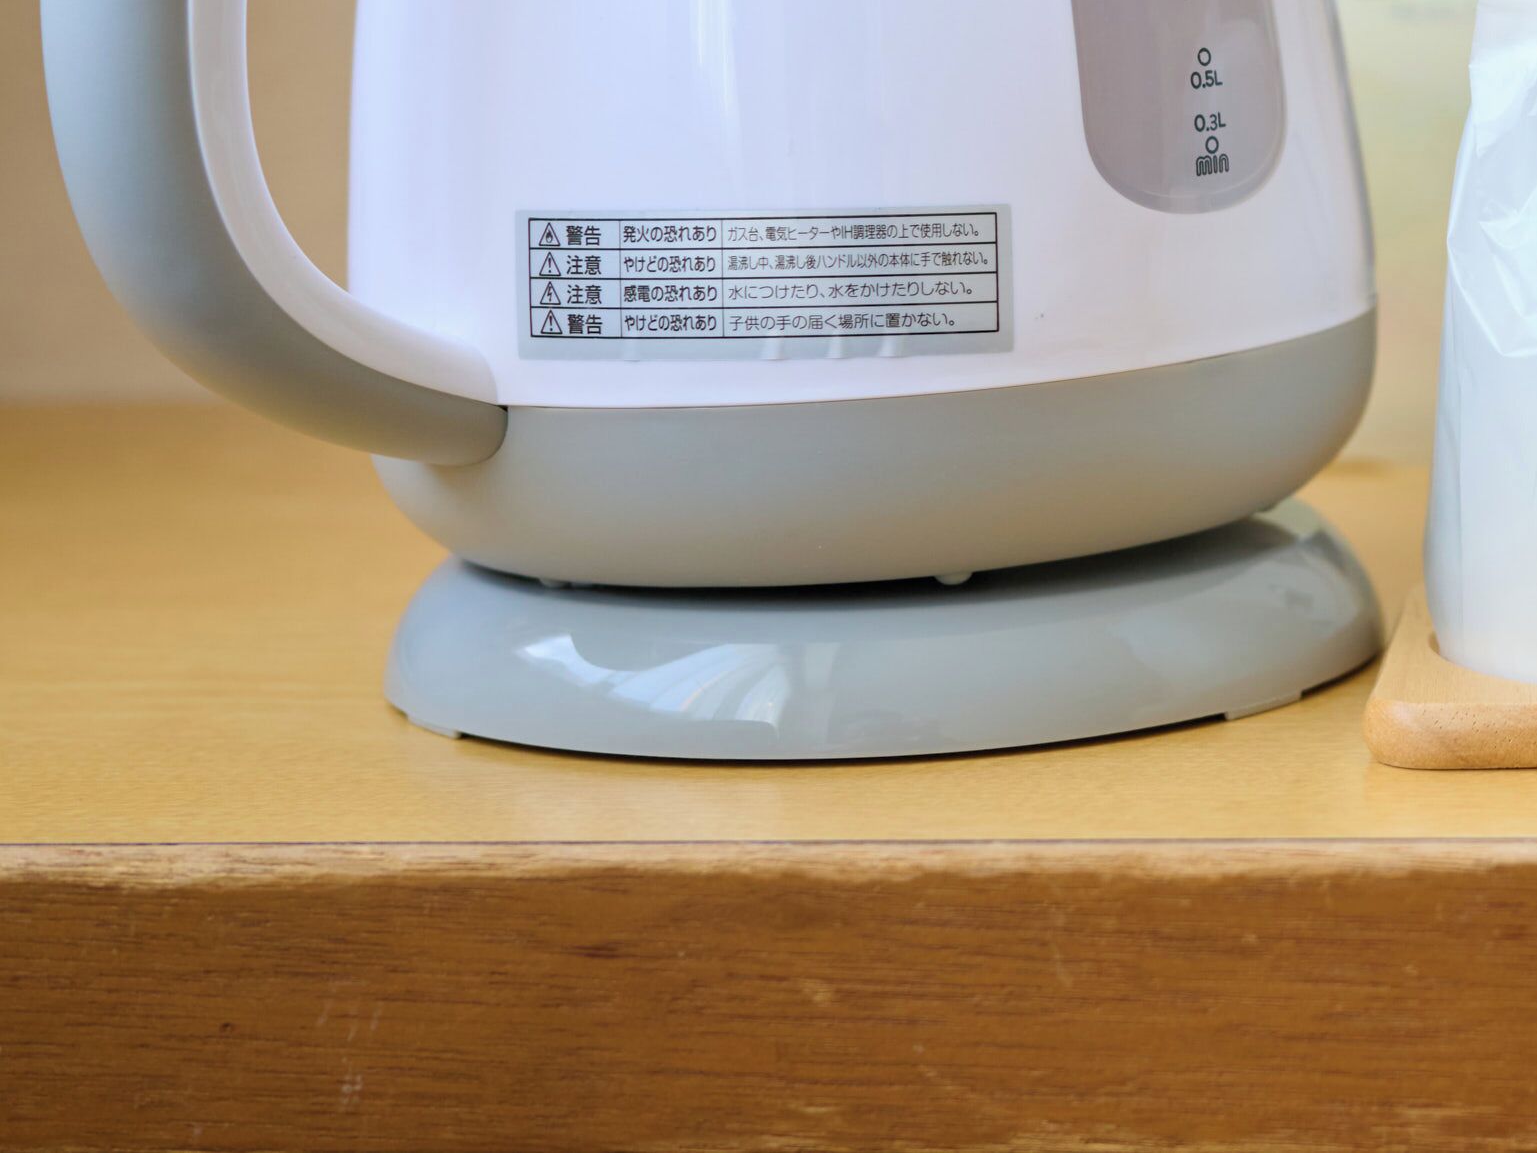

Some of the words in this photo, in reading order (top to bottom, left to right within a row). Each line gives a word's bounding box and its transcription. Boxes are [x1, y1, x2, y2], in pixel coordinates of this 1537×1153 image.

[1190, 70, 1223, 89] 0.5L
[1194, 112, 1226, 132] 0.3L
[566, 225, 602, 246] 警告
[623, 225, 717, 244] 発火の恐れあり
[566, 255, 602, 275] 注意
[623, 255, 717, 273] やけどの恐れあり
[566, 285, 602, 305] 注意
[623, 285, 718, 303] 感電の恐れあり
[728, 281, 973, 301] 水につけたり、水をかけたりしない。
[567, 314, 603, 335] 警告
[624, 315, 717, 332] やけどの恐れあり
[729, 312, 956, 332] 子供の手の届く場所に置かない。
